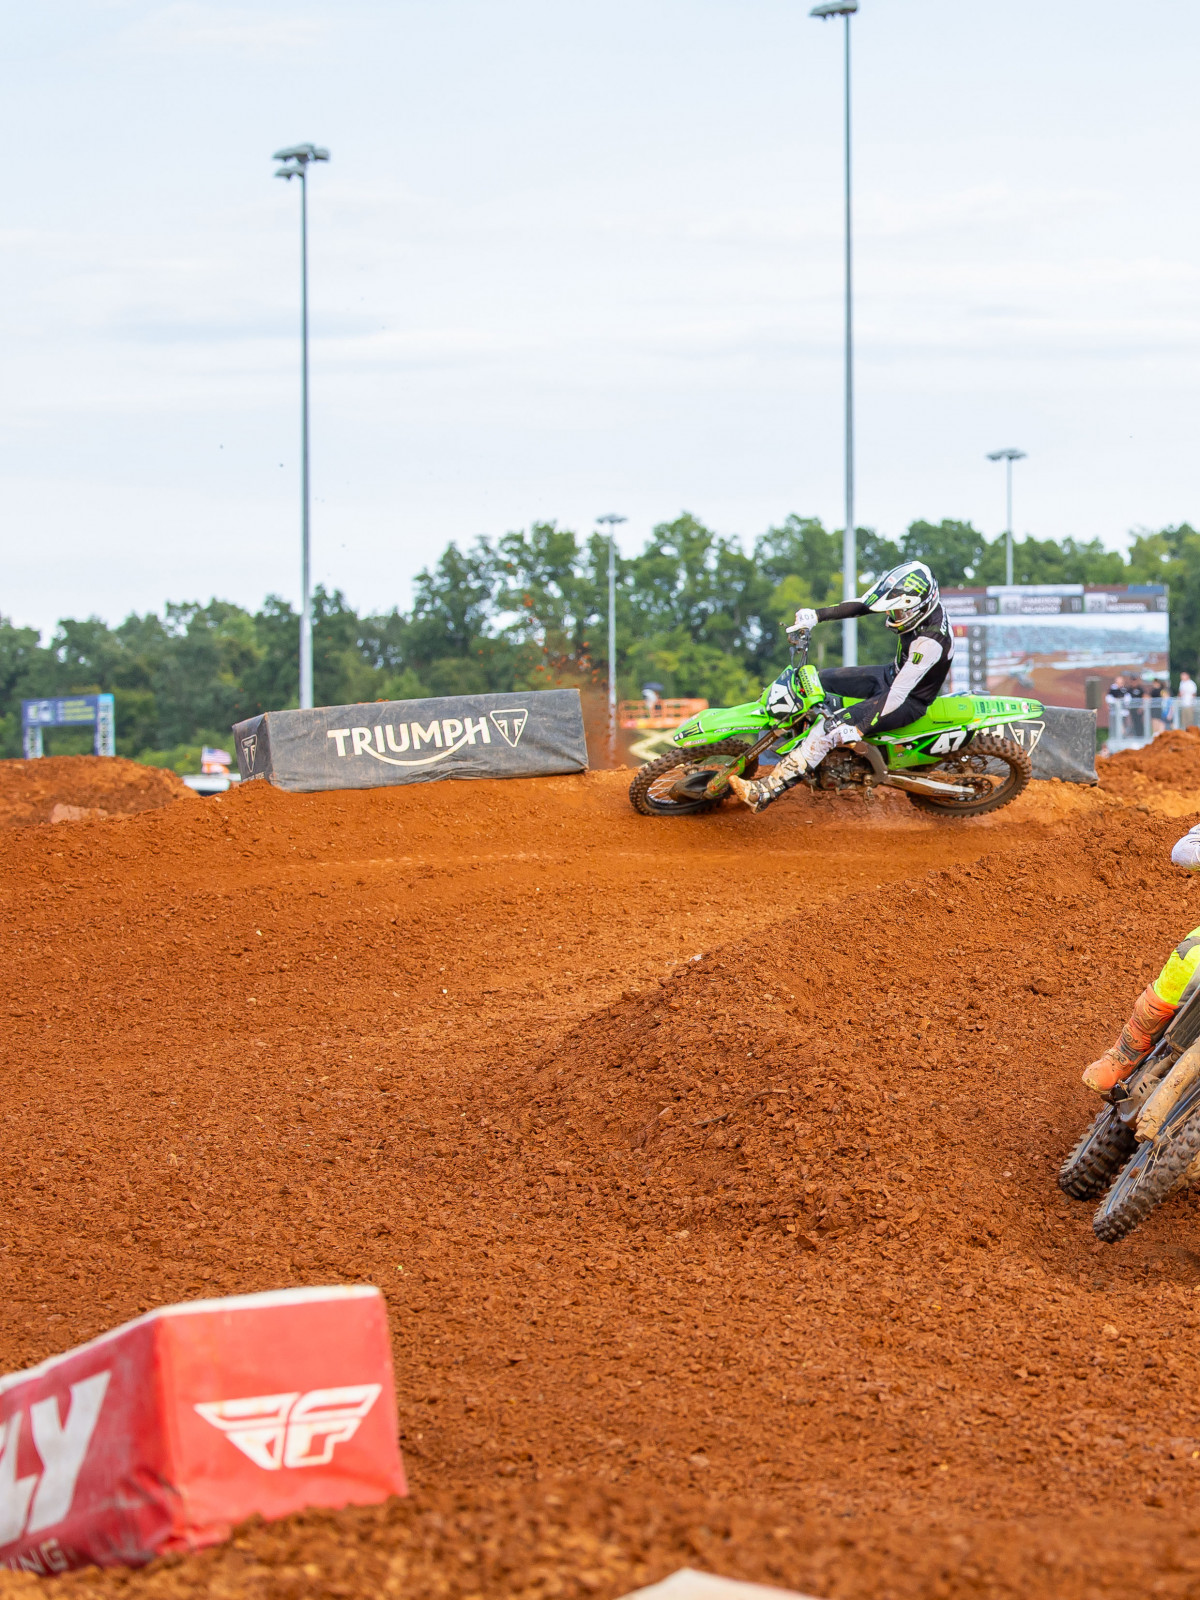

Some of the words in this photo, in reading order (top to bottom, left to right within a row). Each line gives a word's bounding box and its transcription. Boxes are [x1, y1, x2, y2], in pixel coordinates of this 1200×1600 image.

[327, 717, 491, 766] TRIUMPH
[930, 730, 966, 754] 47
[0, 1370, 112, 1548] LY
